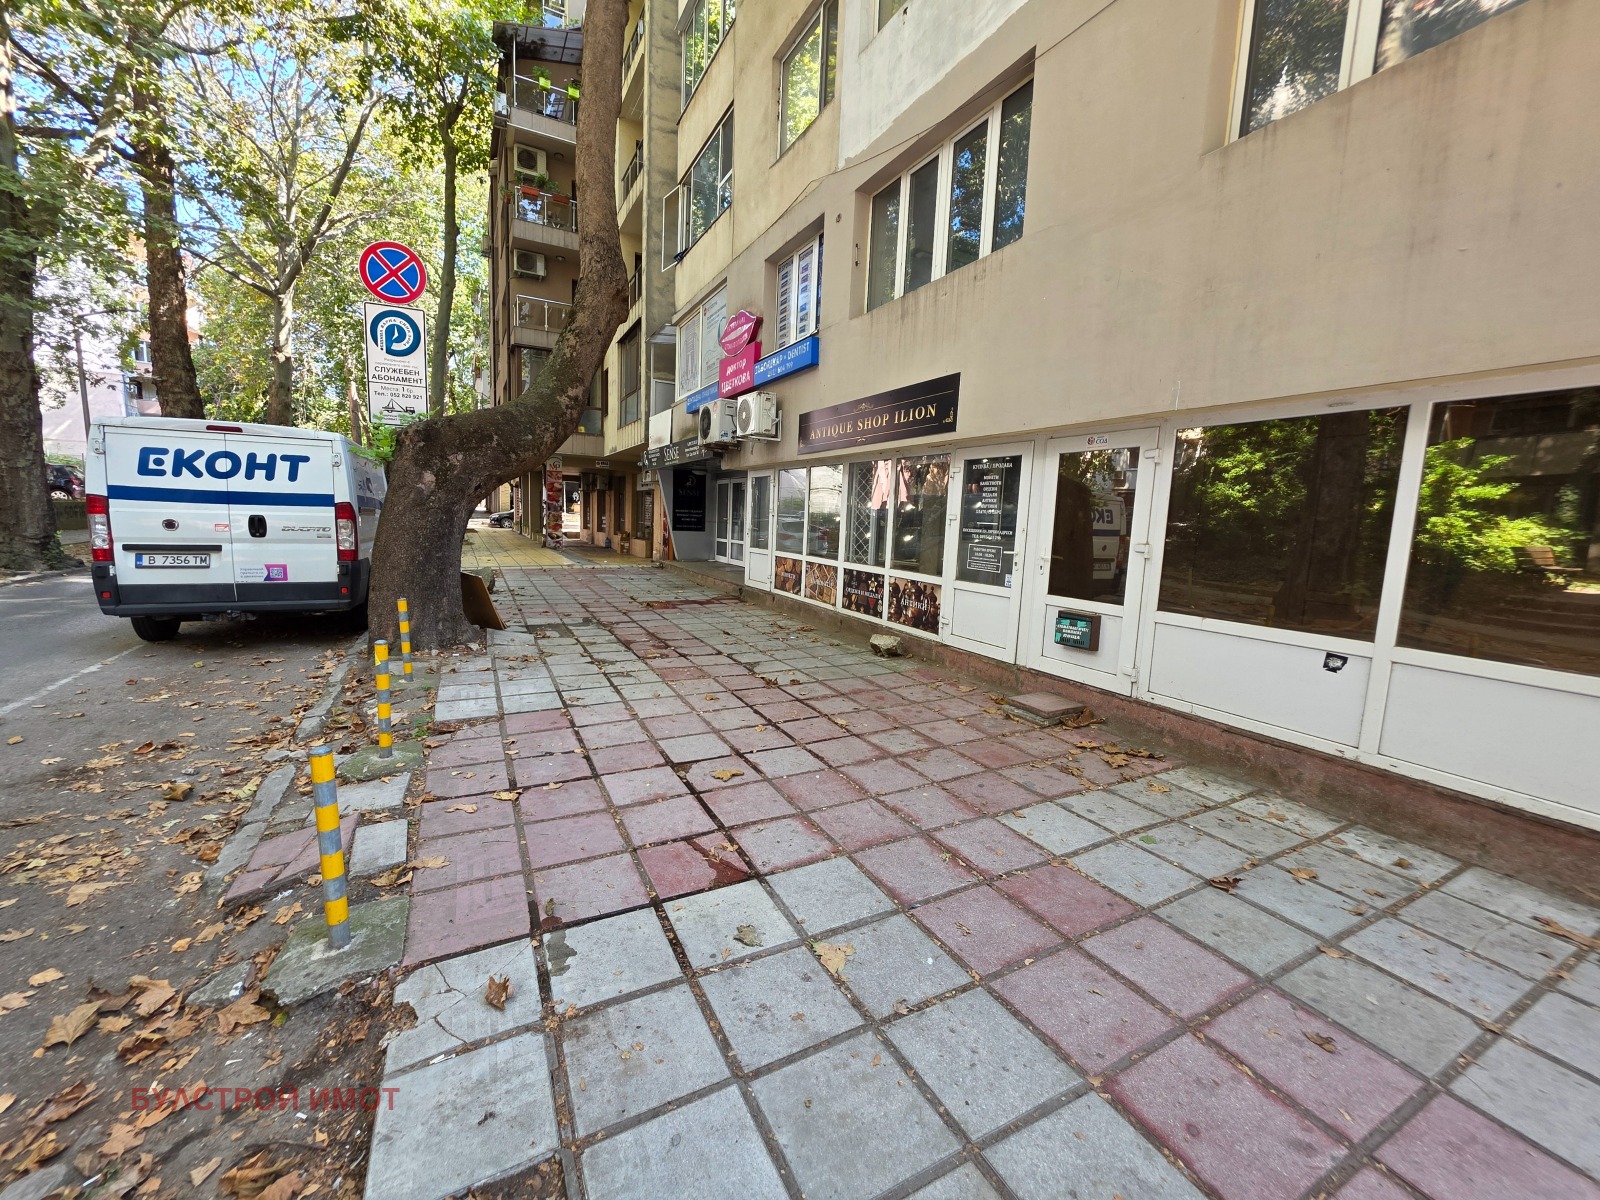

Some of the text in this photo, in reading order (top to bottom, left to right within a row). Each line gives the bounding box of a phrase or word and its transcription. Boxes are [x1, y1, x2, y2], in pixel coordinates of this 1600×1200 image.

[787, 341, 810, 360] DENTIST
[371, 374, 423, 384] АБОНАМЕНТ
[374, 366, 420, 376] СЛУЖЕБЕН
[721, 371, 751, 394] ЦВЕТКОВА
[809, 403, 937, 440] ANTIQUE SHOP ILION
[663, 446, 680, 462] SENSE
[137, 446, 311, 482] ЕКОНТ
[148, 555, 208, 565] B 7356 TM
[900, 598, 928, 610] АНТИКИ
